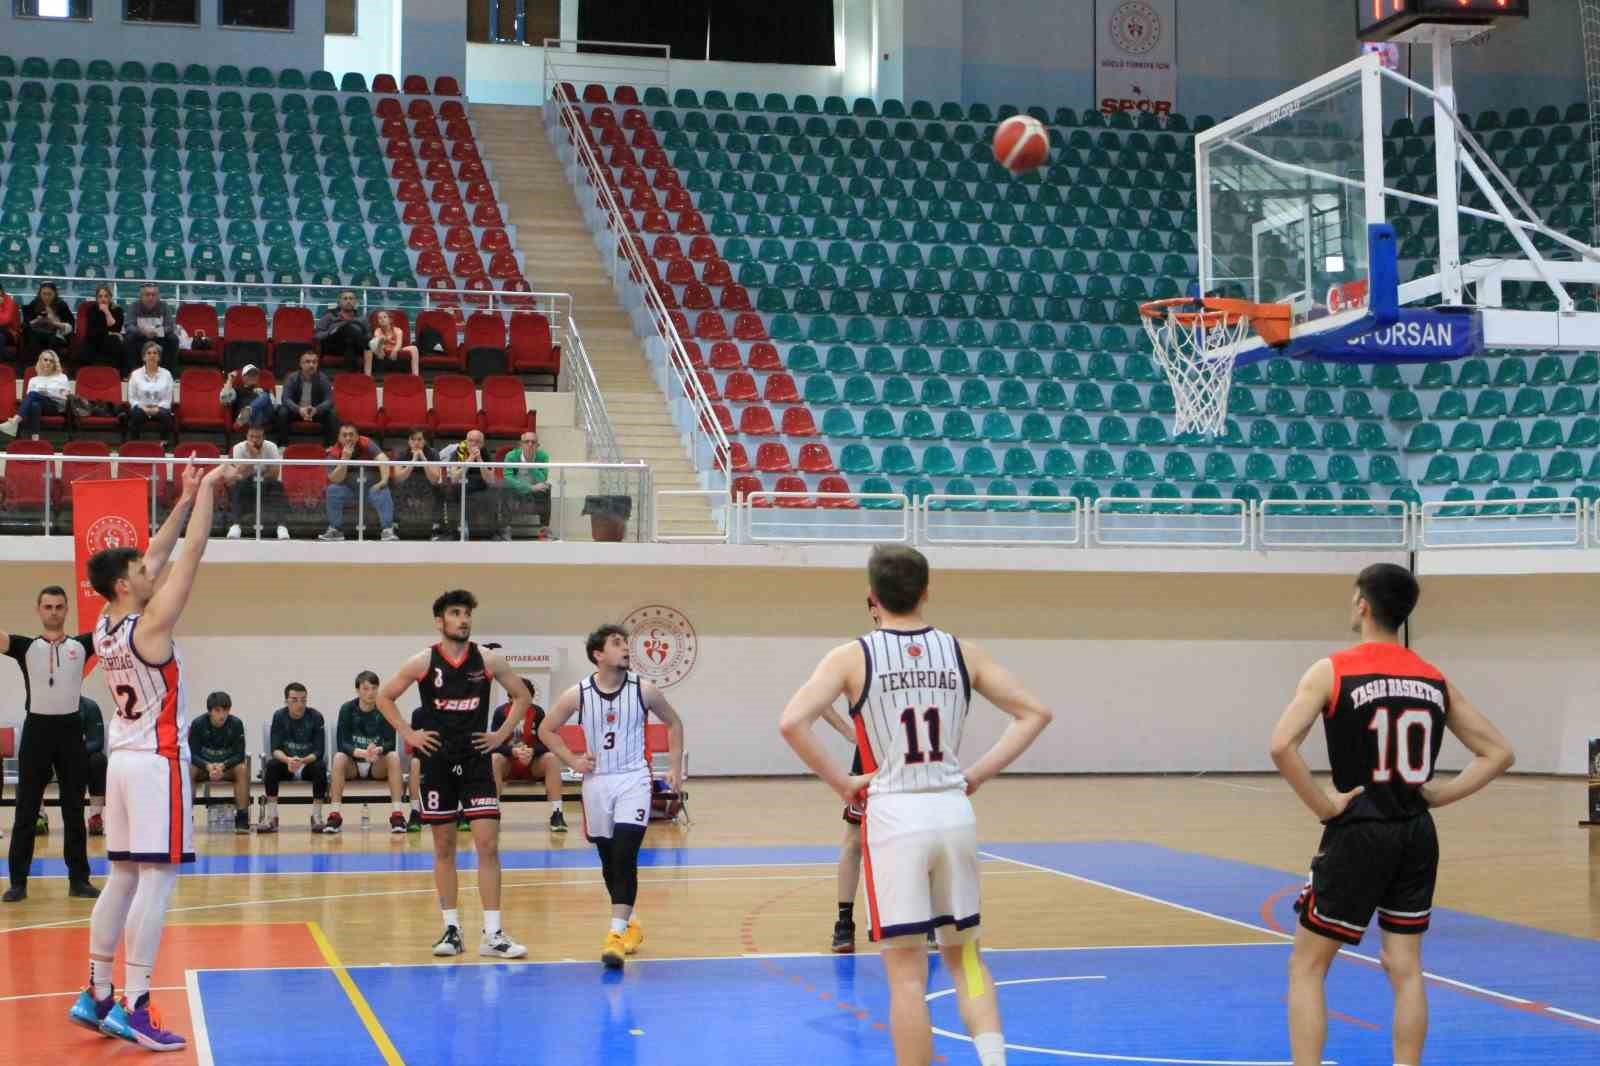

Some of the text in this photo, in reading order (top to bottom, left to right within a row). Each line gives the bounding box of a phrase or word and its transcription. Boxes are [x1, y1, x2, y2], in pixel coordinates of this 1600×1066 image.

[603, 731, 616, 751] 3
[900, 706, 944, 765] 11
[1367, 706, 1433, 784] 10
[427, 790, 440, 810] 8
[634, 808, 647, 822] 3
